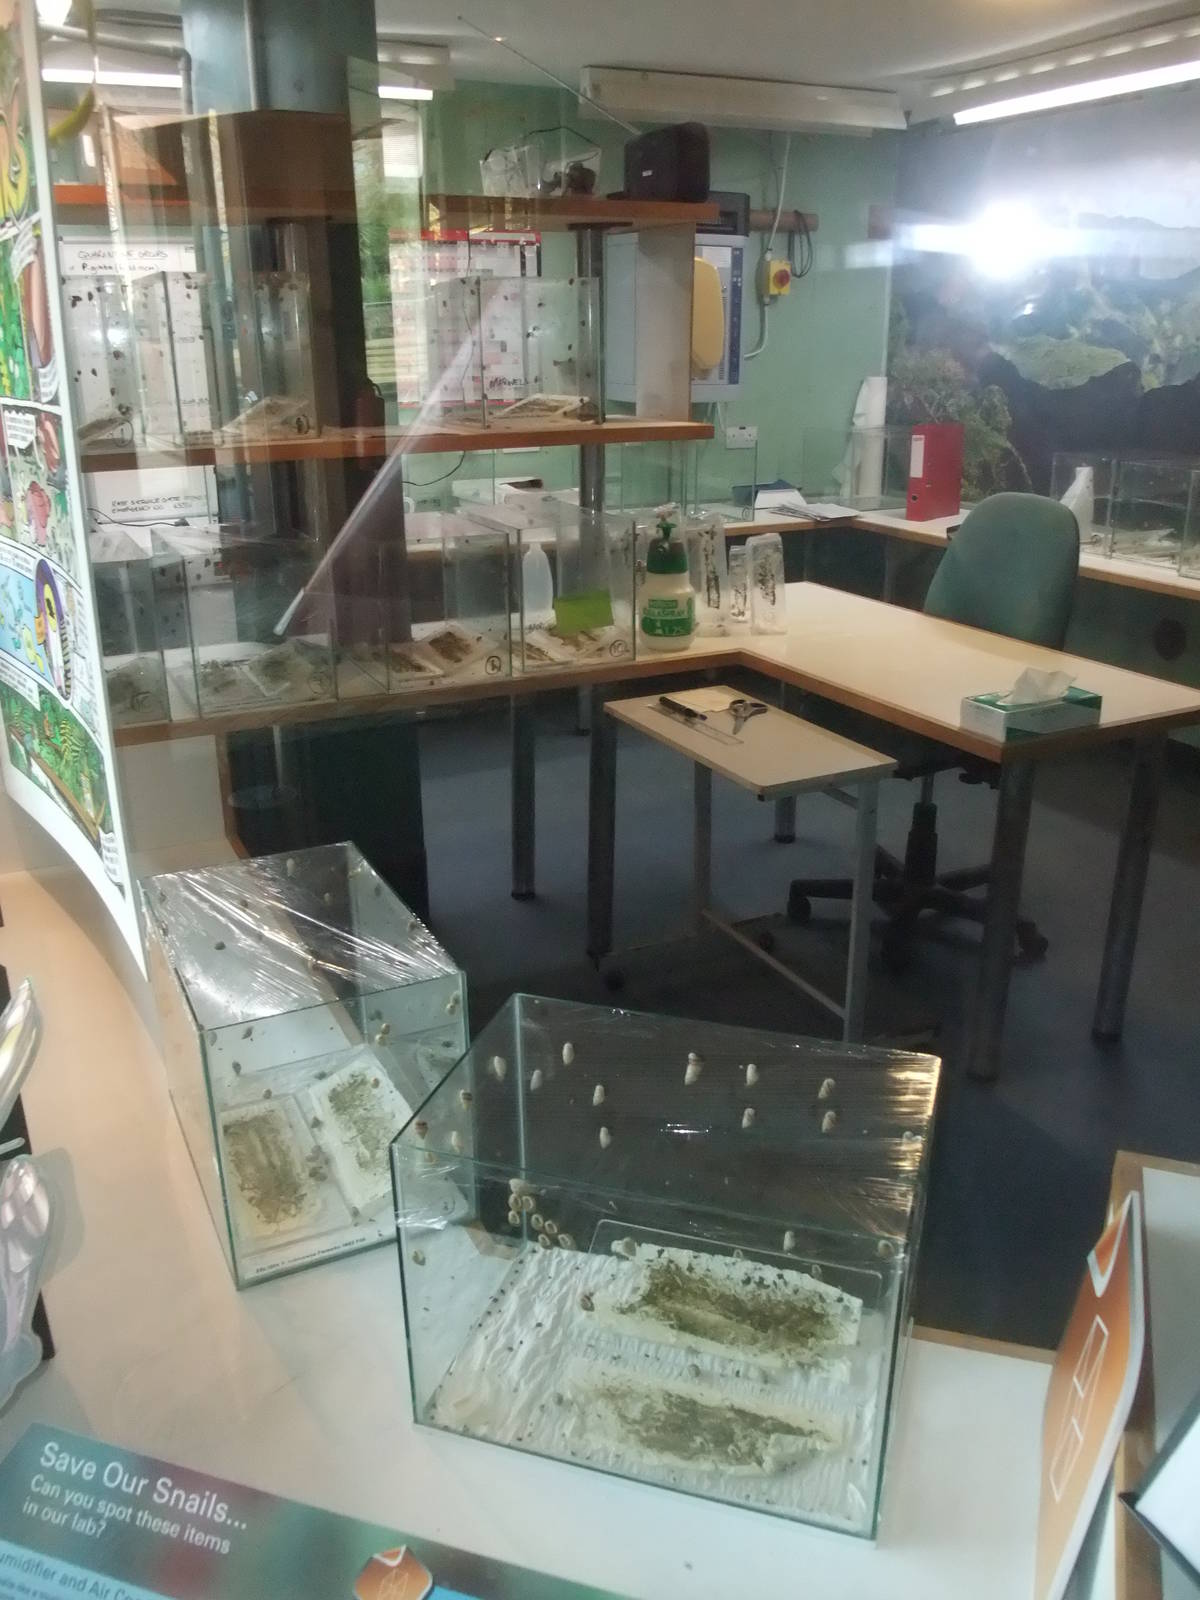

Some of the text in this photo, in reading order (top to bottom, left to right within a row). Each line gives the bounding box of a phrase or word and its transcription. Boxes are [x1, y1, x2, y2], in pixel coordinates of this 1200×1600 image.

[39, 1440, 97, 1481] Save
[102, 1461, 149, 1497] Our
[22, 1496, 107, 1540] in our lab?
[30, 1473, 232, 1555] Can you spot these items
[59, 1572, 88, 1592] and
[88, 1580, 111, 1599] Air
